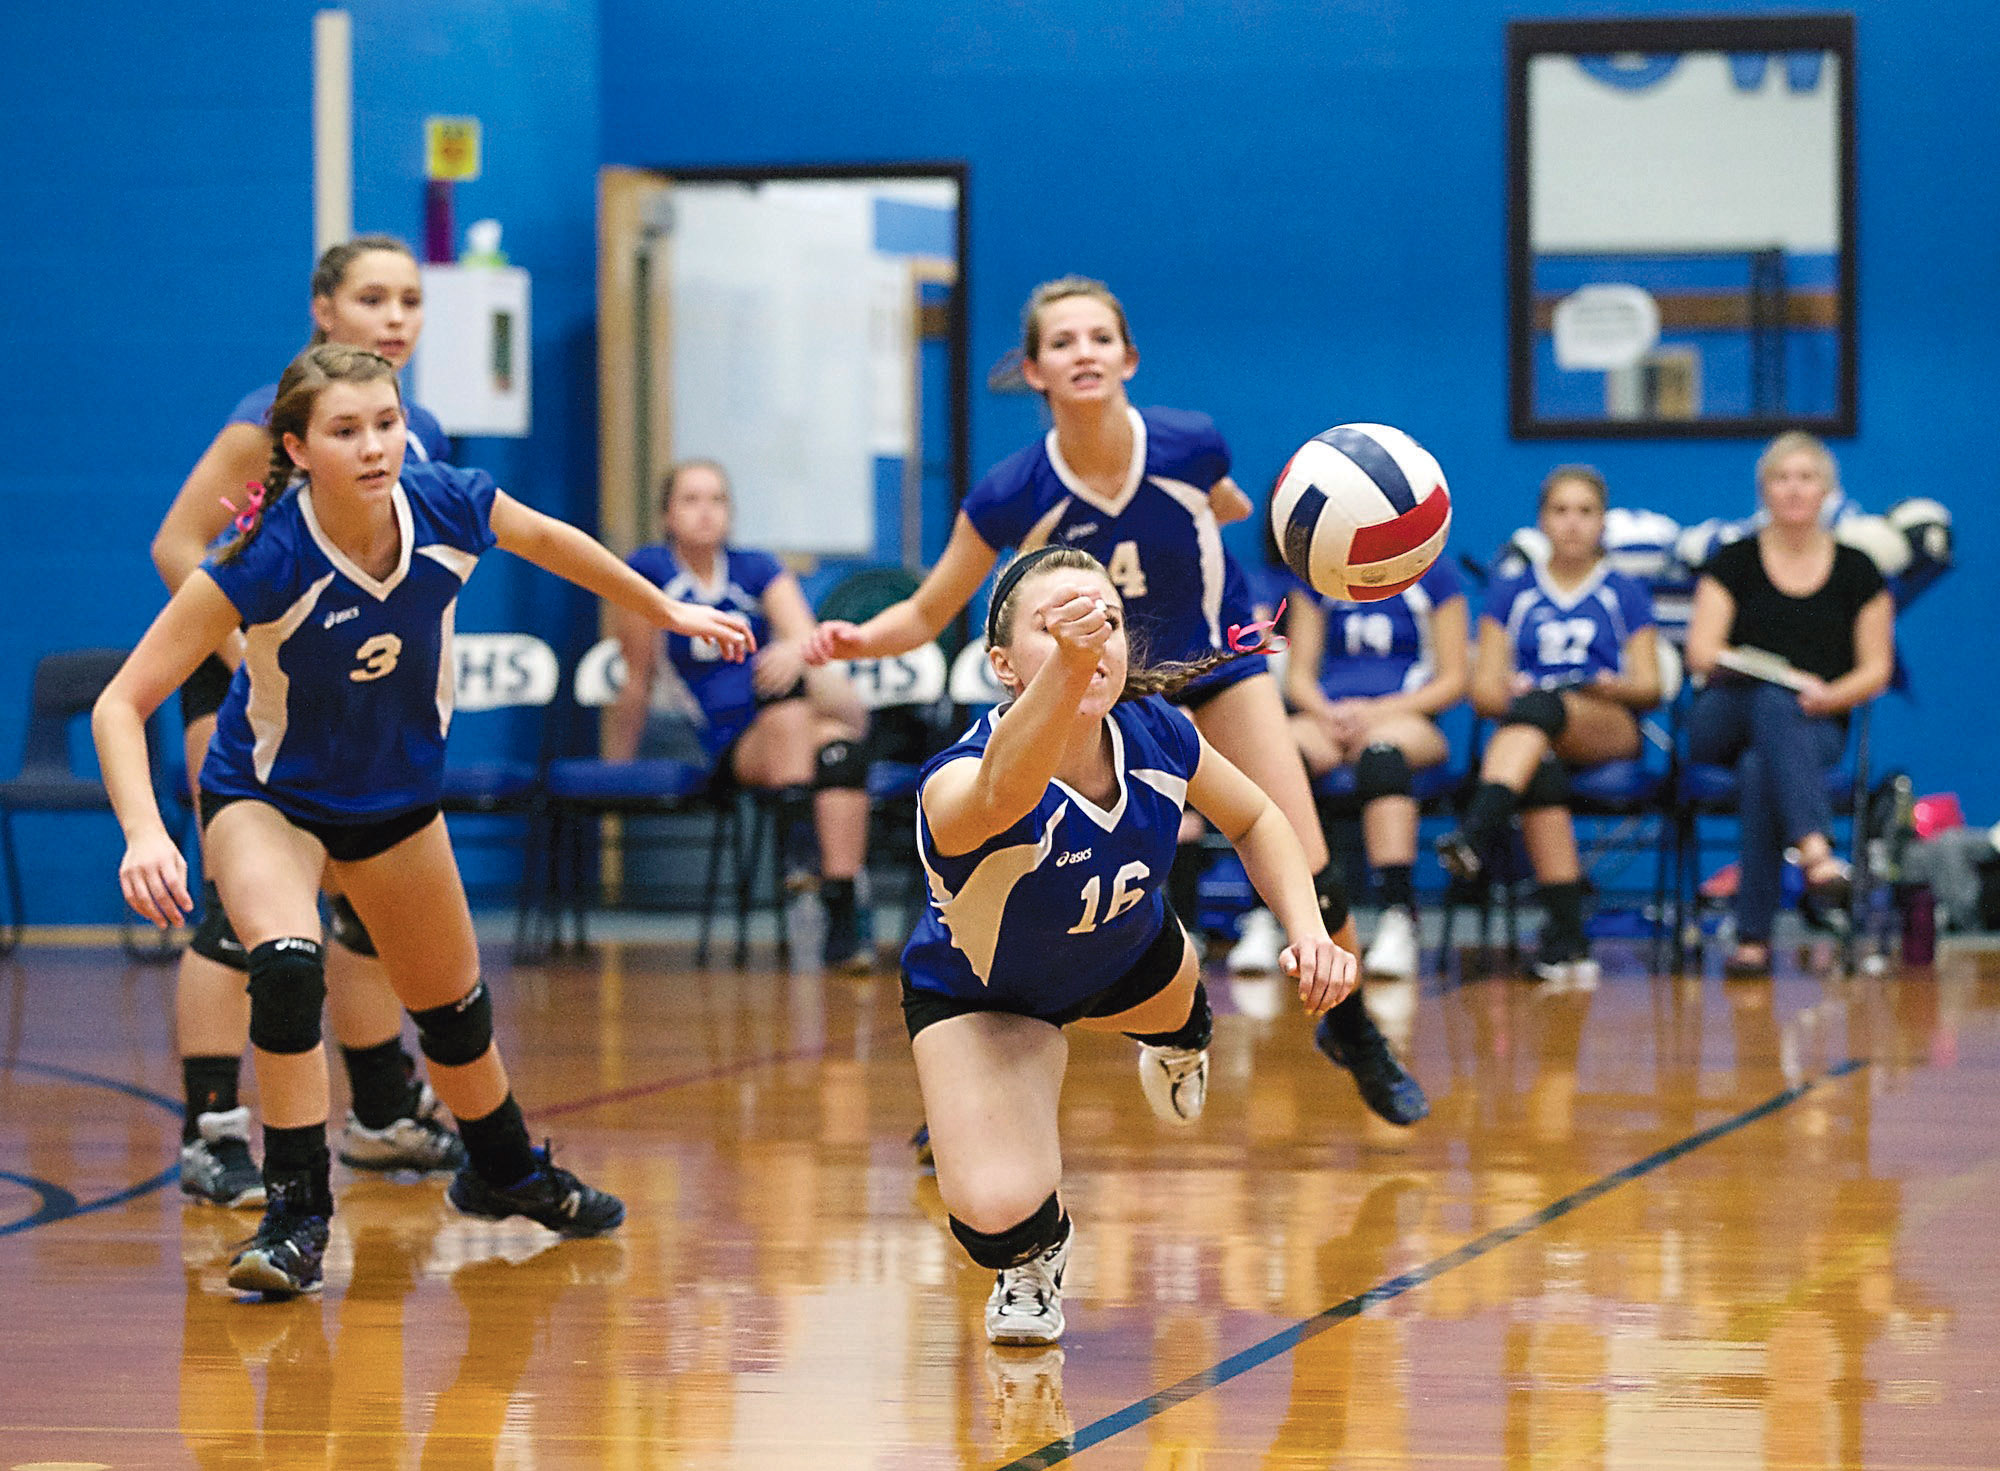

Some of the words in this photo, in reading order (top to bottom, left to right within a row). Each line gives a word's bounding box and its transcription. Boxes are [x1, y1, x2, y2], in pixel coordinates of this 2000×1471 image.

[1108, 540, 1148, 598] 4
[349, 632, 402, 682] 3
[458, 650, 529, 693] HS
[1066, 847, 1093, 865] asics
[1066, 859, 1150, 935] 16
